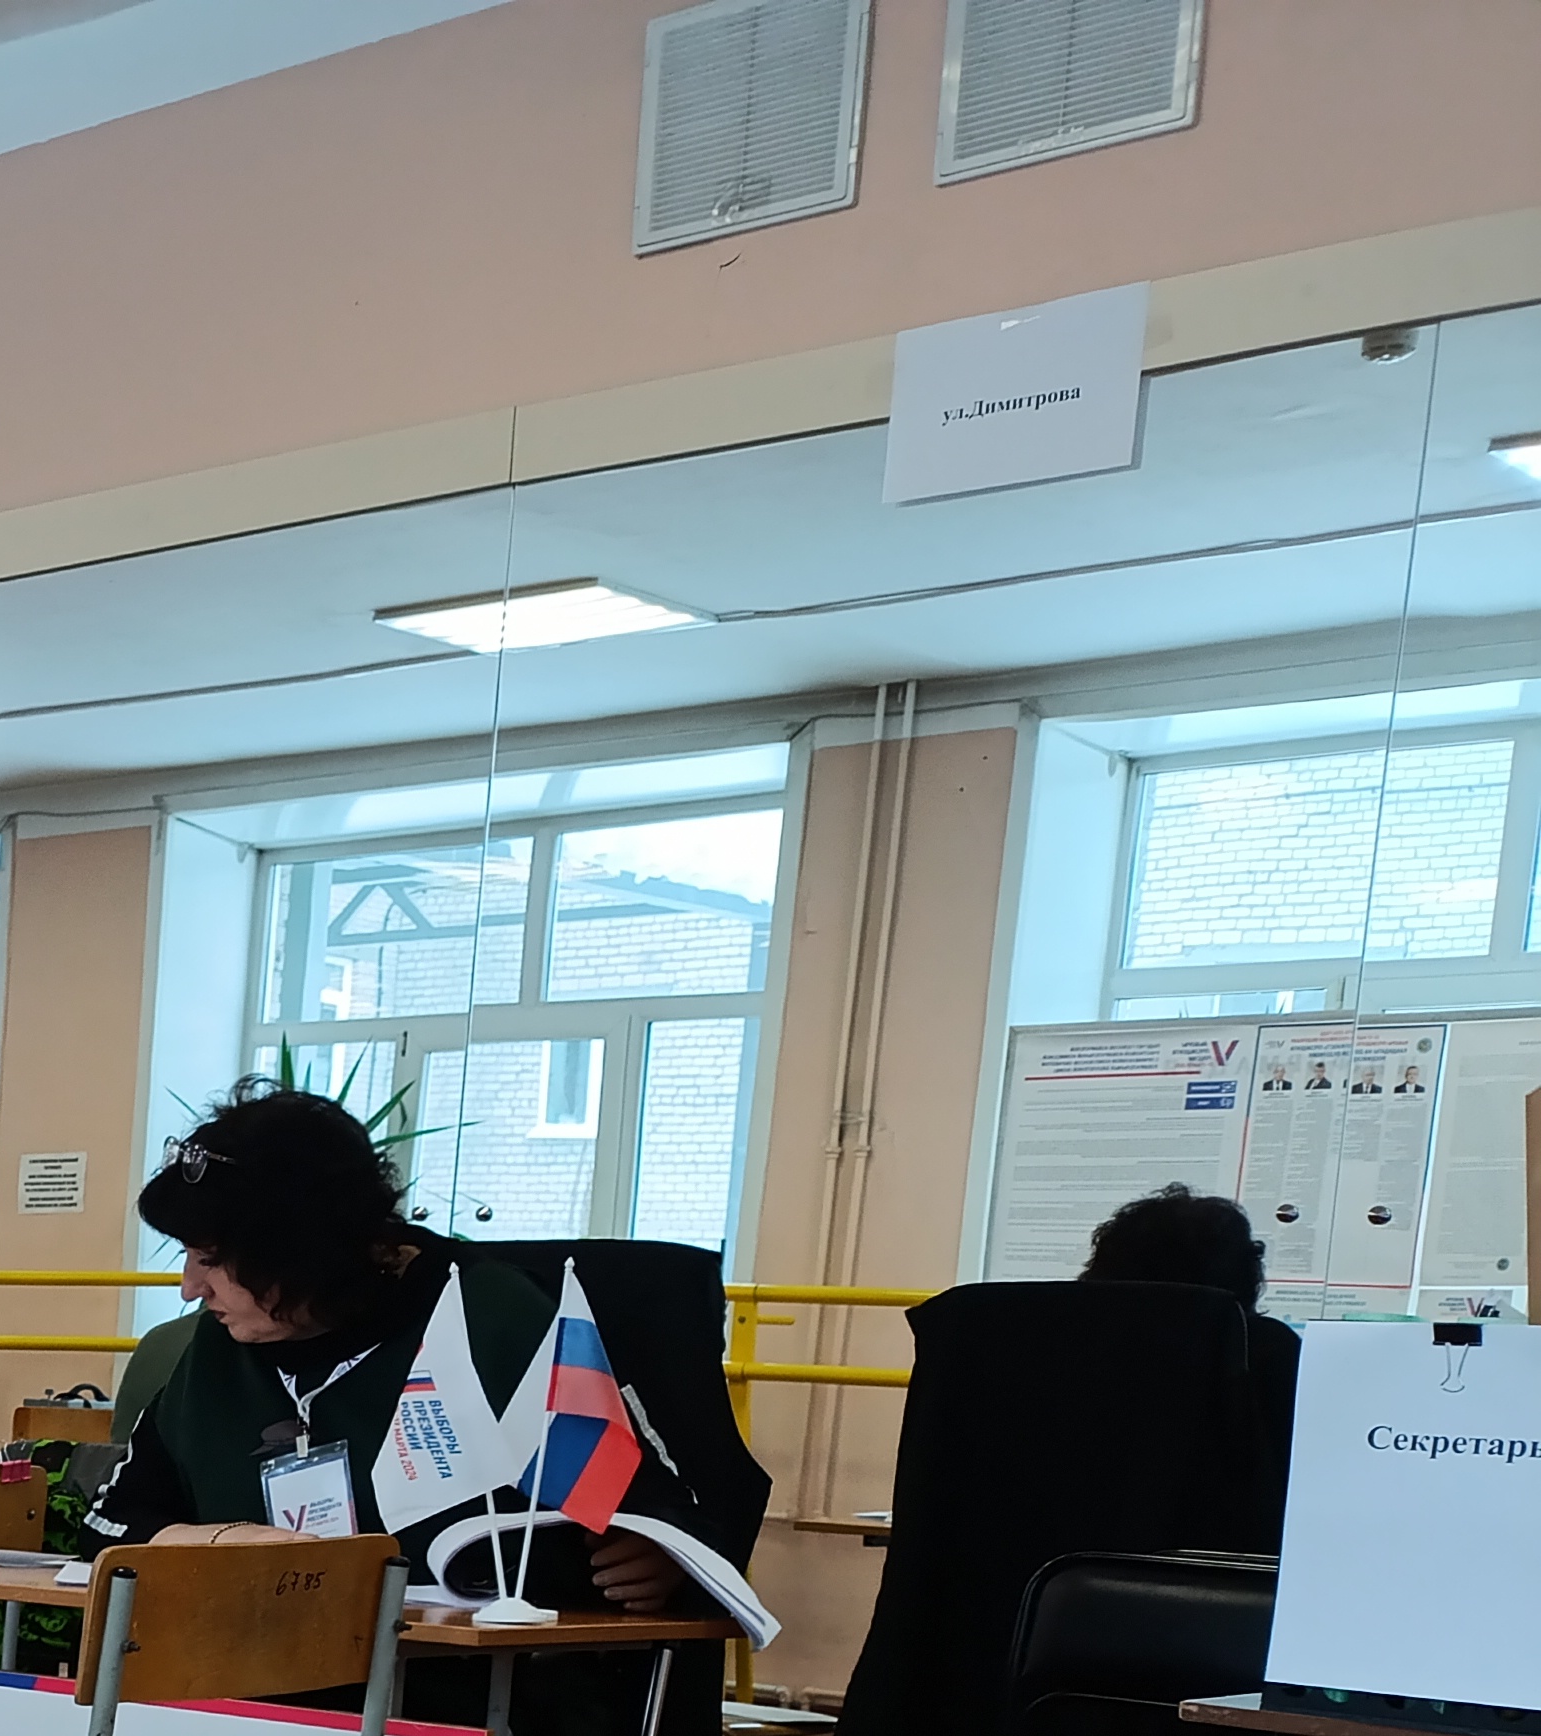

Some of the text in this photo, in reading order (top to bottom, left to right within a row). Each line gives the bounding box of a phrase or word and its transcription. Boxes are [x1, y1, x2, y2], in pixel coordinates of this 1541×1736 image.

[941, 386, 1081, 427] ул.Димитрова
[400, 1401, 423, 1450] РОССИИ
[412, 1400, 453, 1479] ПРЕЗИДЕНТА
[428, 1400, 462, 1454] ВЫБОРЫ
